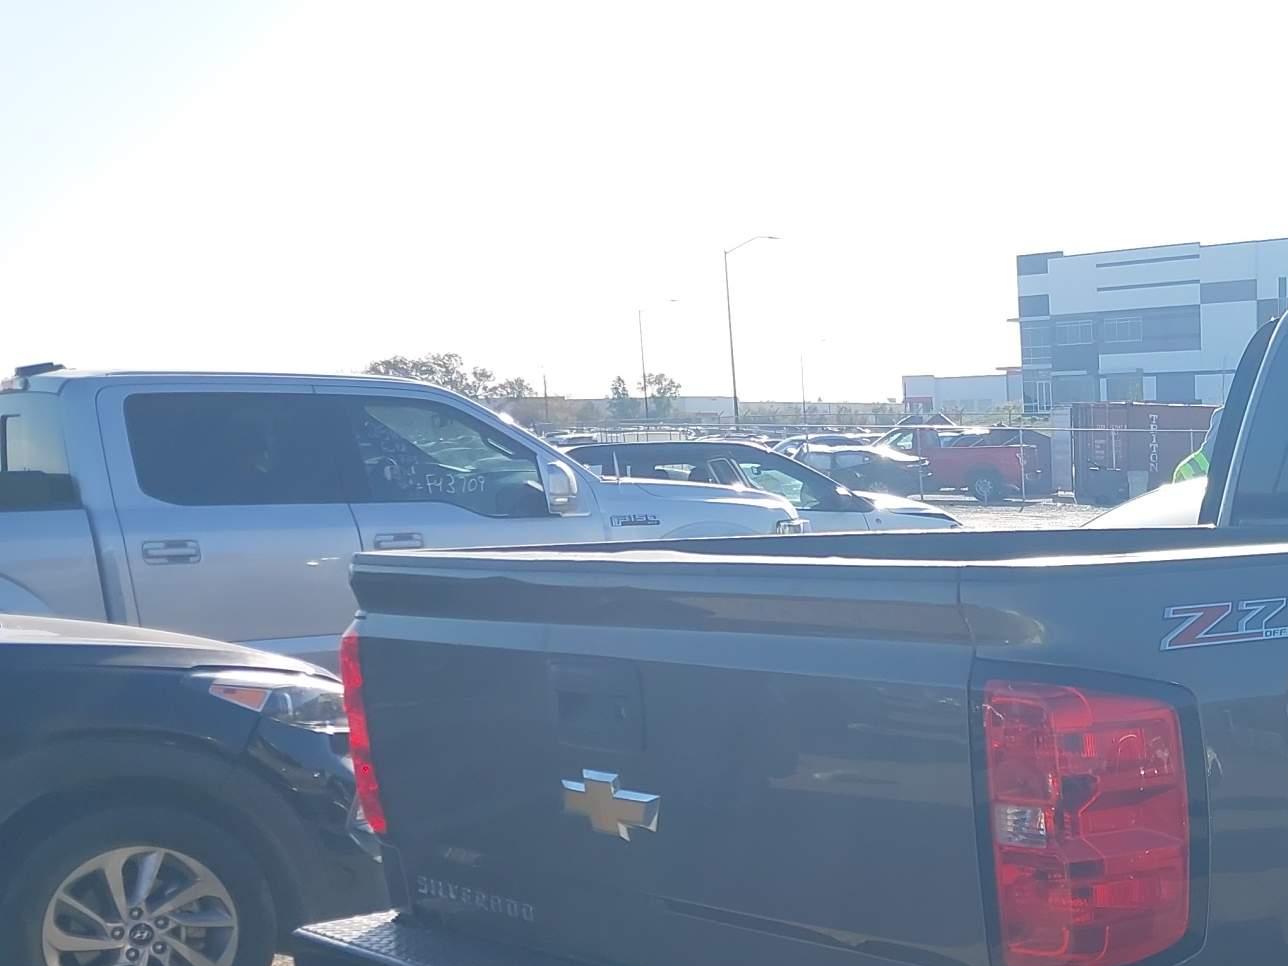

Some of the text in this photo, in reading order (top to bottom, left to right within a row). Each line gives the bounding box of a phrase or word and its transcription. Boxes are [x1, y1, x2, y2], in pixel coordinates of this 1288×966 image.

[1148, 413, 1159, 473] TRITON
[1264, 628, 1288, 638] OFF
[417, 874, 535, 922] SILVERADO
